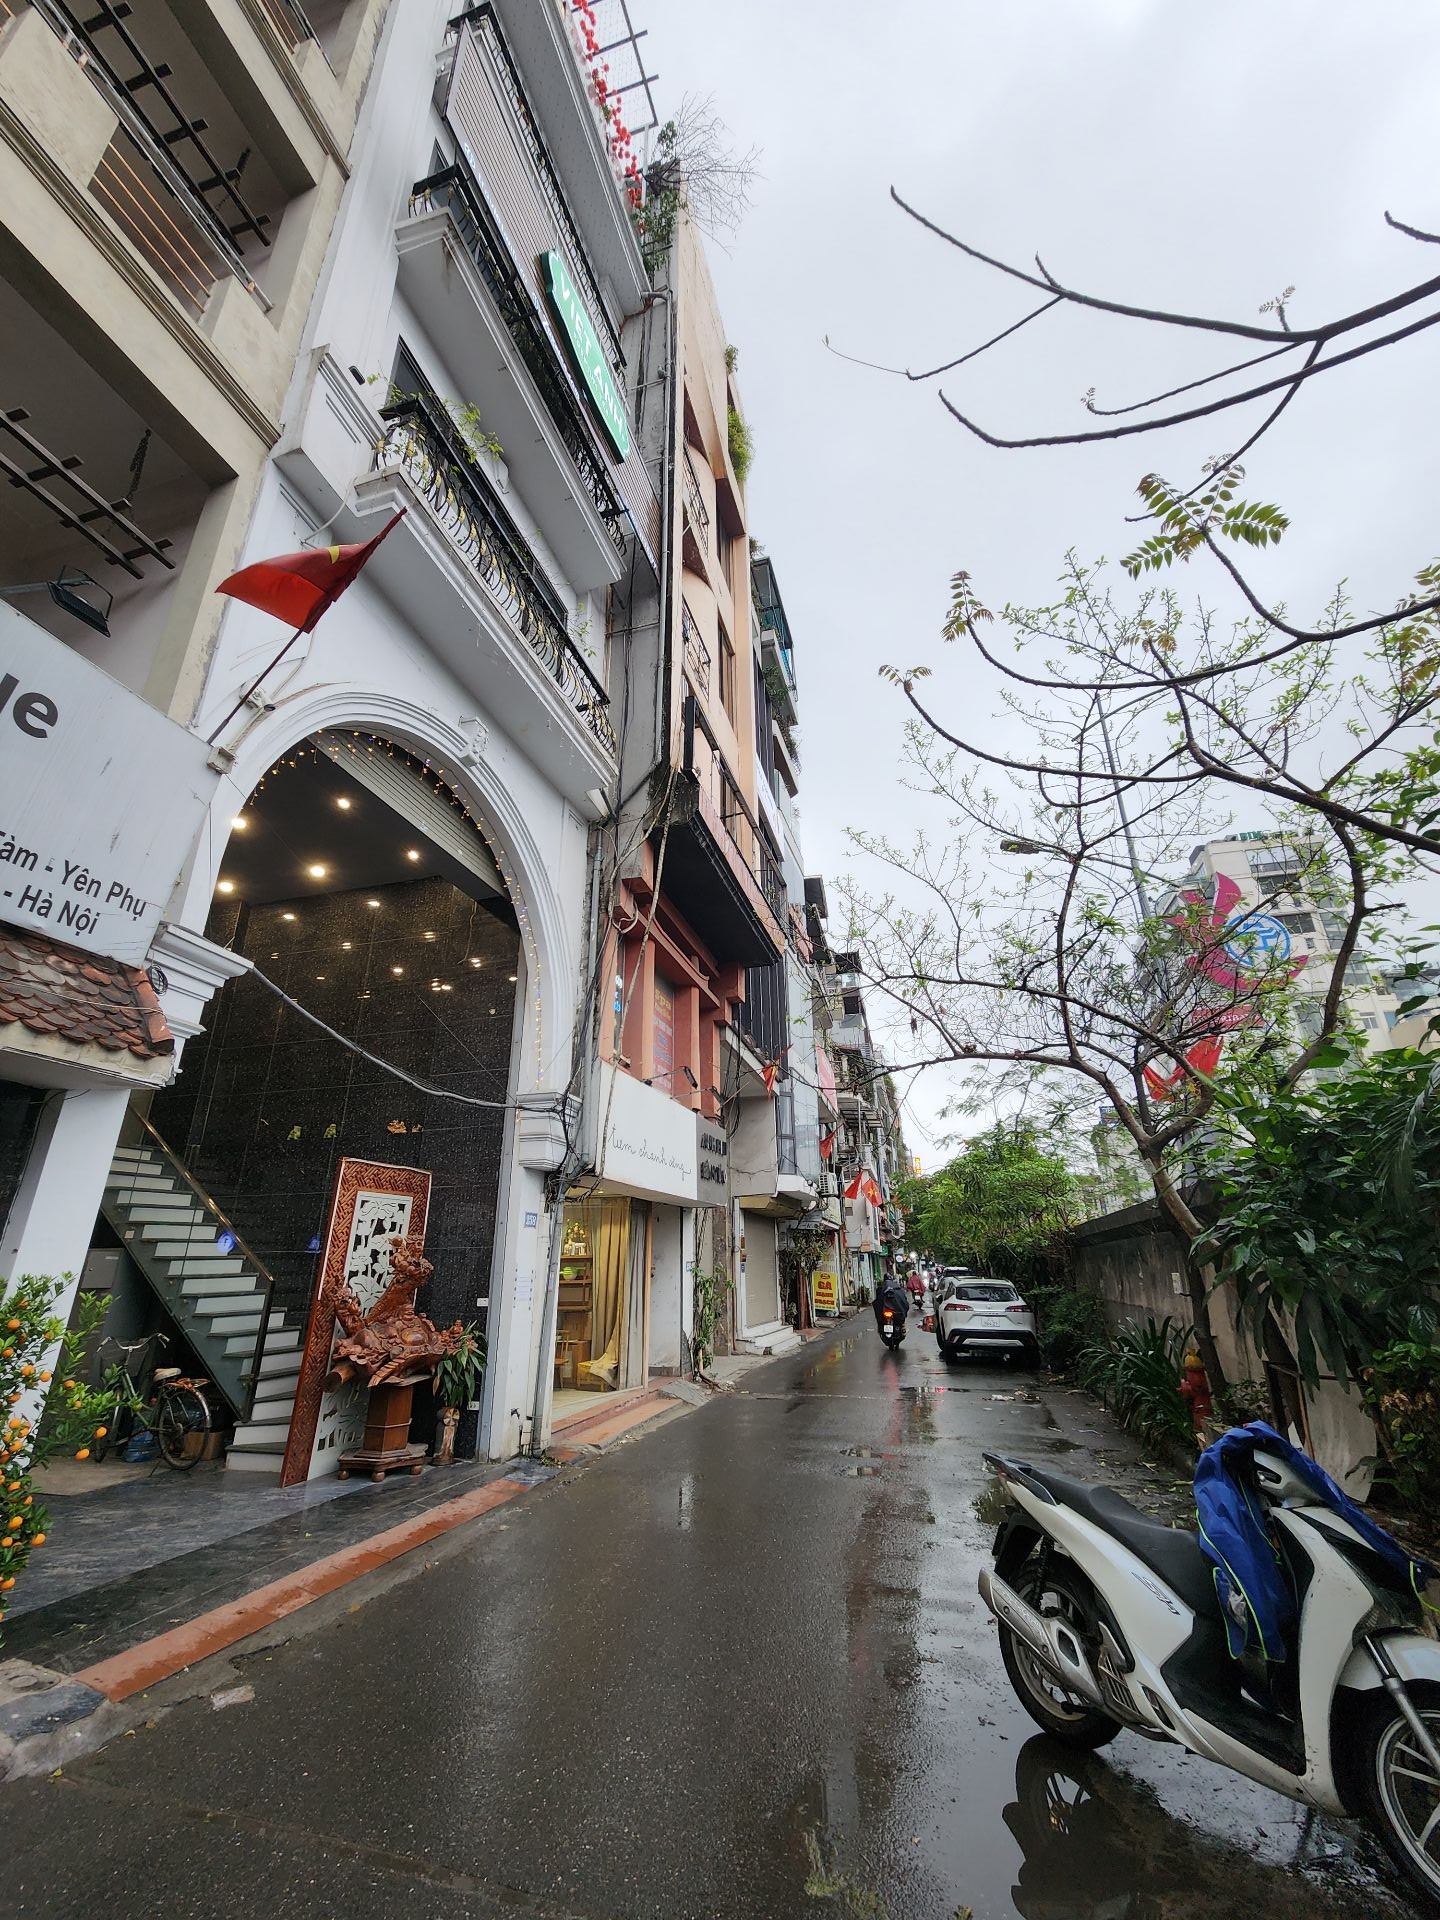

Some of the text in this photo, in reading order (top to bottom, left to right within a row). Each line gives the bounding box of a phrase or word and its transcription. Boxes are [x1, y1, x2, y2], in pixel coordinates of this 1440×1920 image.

[17, 884, 53, 919] Hà
[56, 899, 101, 937] Nội
[61, 859, 102, 898] Yên
[104, 880, 147, 921] Phụ
